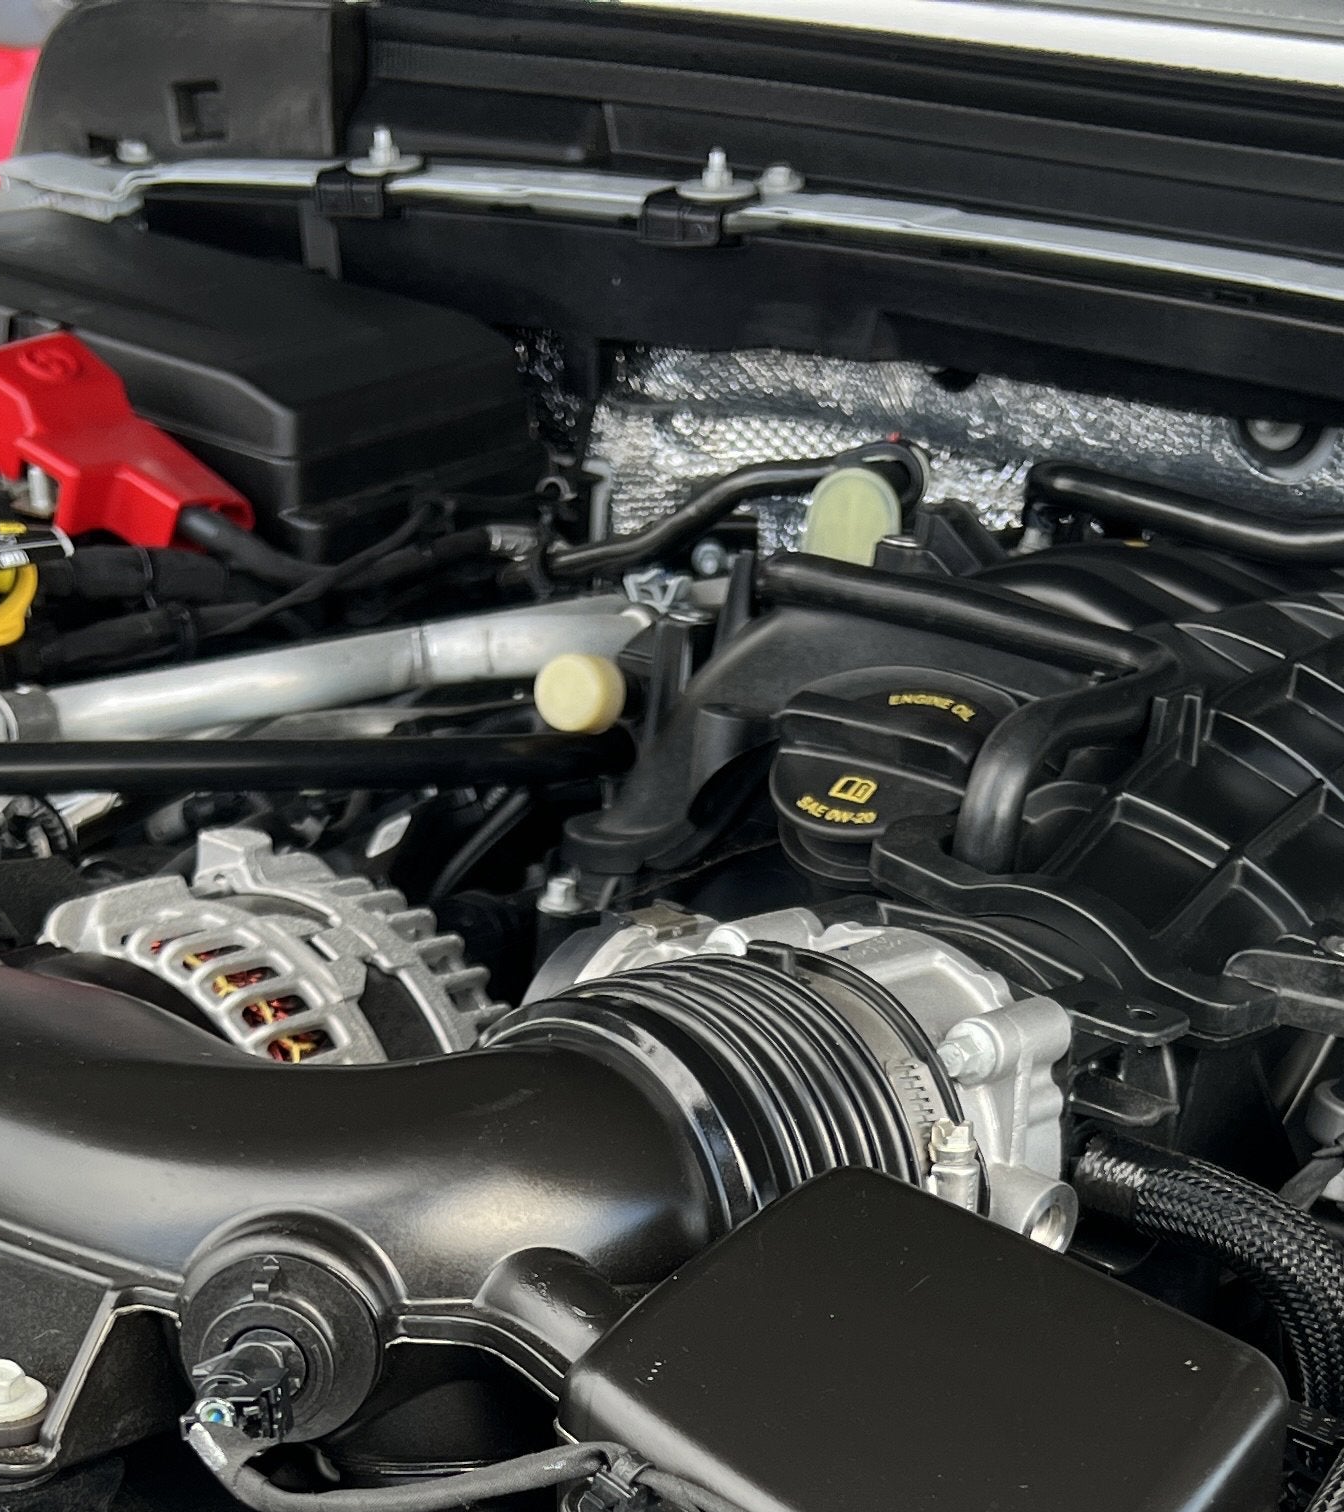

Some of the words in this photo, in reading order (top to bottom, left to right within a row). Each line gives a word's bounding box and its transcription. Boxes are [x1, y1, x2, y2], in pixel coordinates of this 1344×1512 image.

[888, 694, 955, 710] ENGINE
[796, 796, 829, 818] SAE
[824, 809, 877, 824] 0W-20
